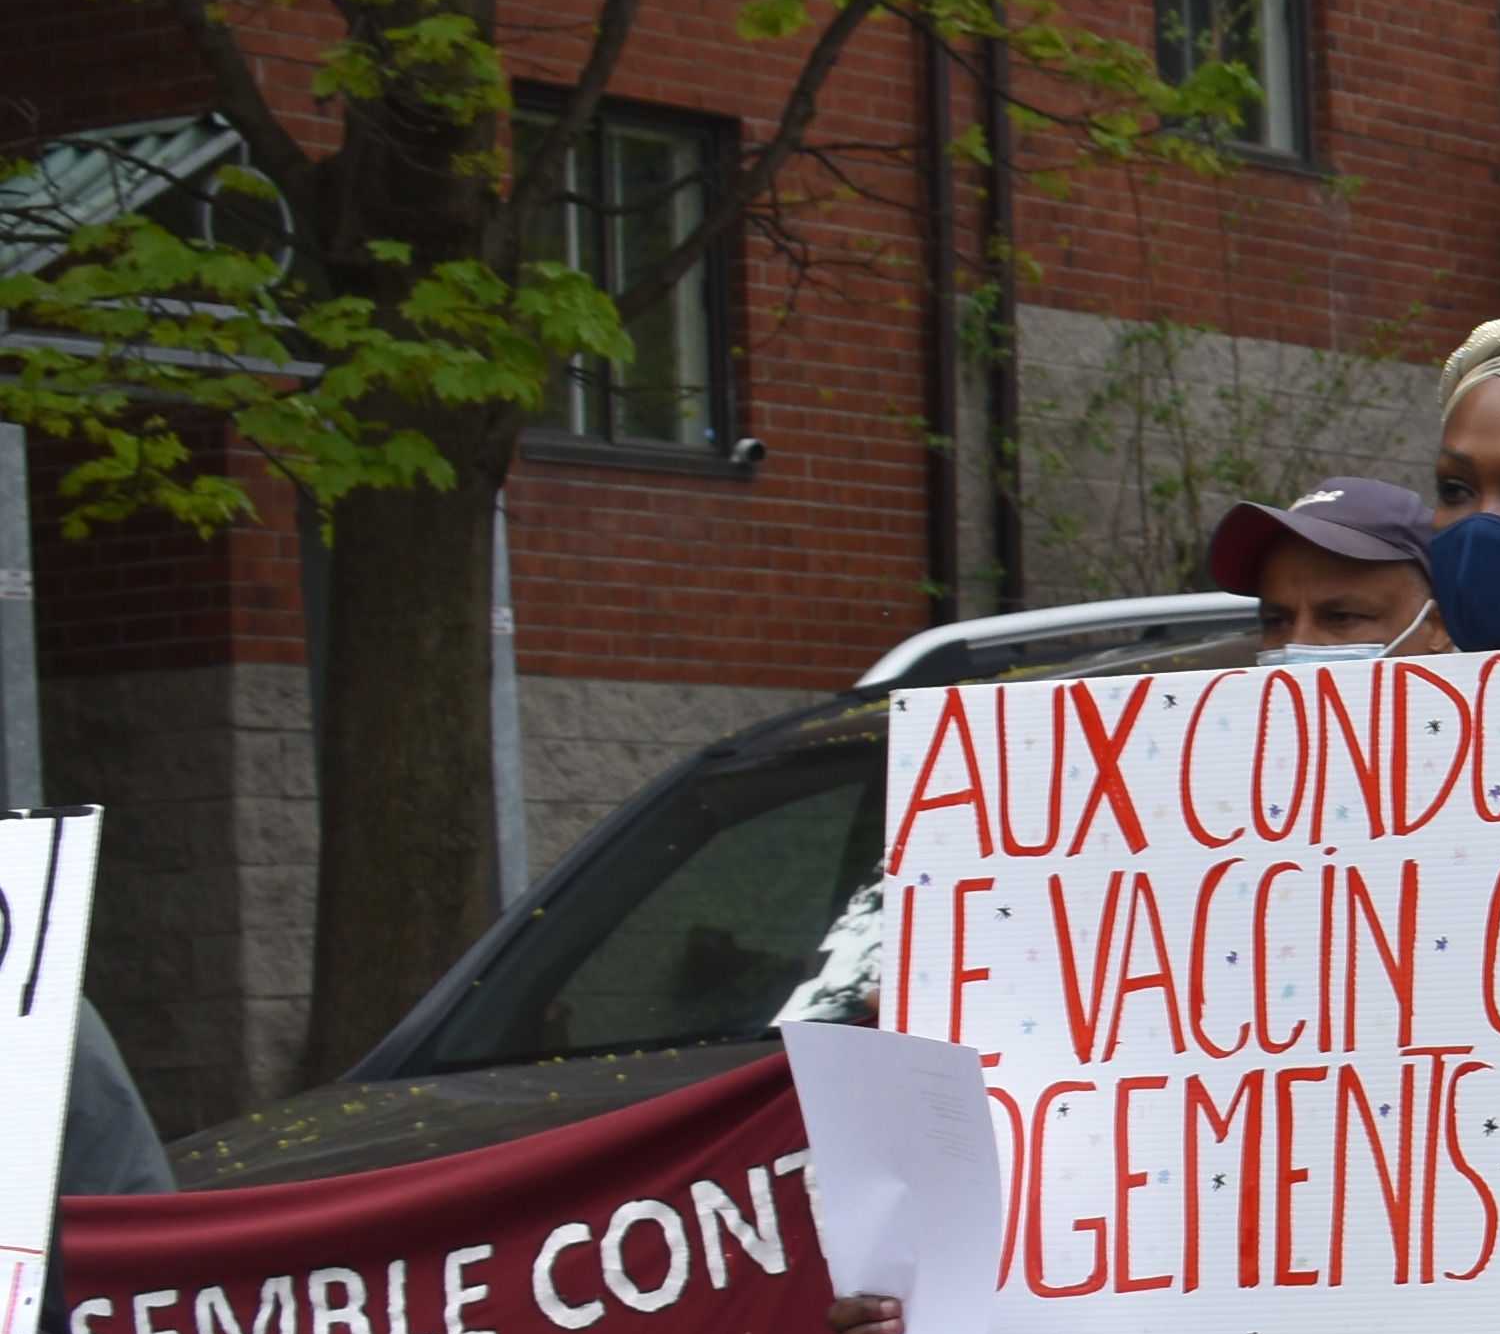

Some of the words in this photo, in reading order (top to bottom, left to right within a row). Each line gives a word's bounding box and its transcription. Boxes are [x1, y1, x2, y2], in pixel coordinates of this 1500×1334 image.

[890, 678, 1152, 874] AUX
[1051, 847, 1419, 1066] VACCIN
[986, 1046, 1499, 1298] OGEMENTS
